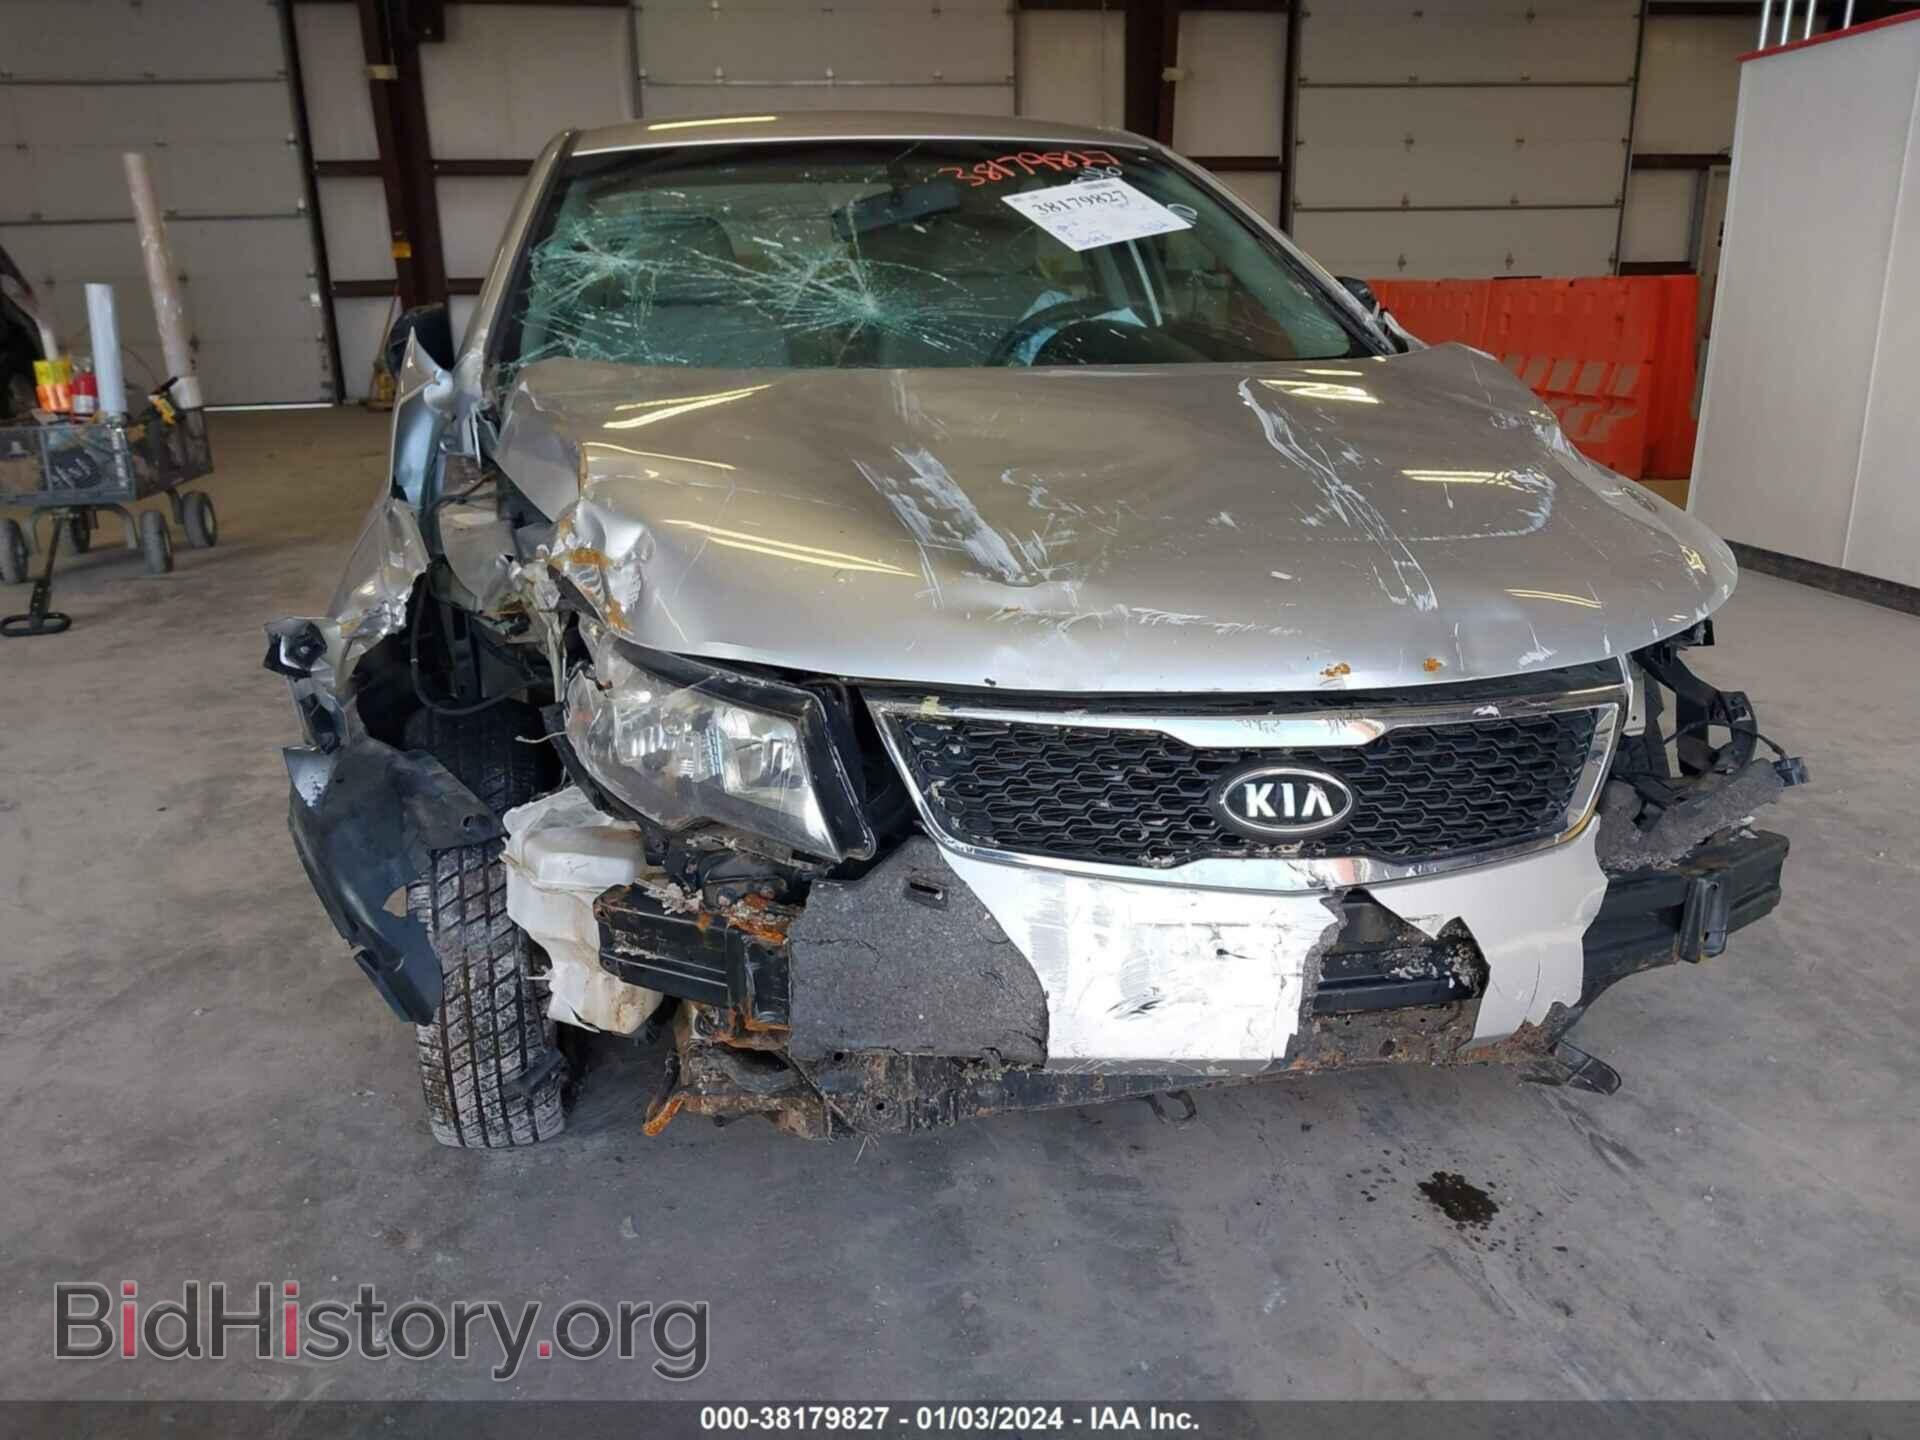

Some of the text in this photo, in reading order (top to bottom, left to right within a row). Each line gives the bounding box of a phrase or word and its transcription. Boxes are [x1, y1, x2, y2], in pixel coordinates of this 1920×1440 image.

[938, 150, 1121, 187] 38179827
[1031, 189, 1129, 216] 38179827
[1244, 782, 1333, 817] KIA
